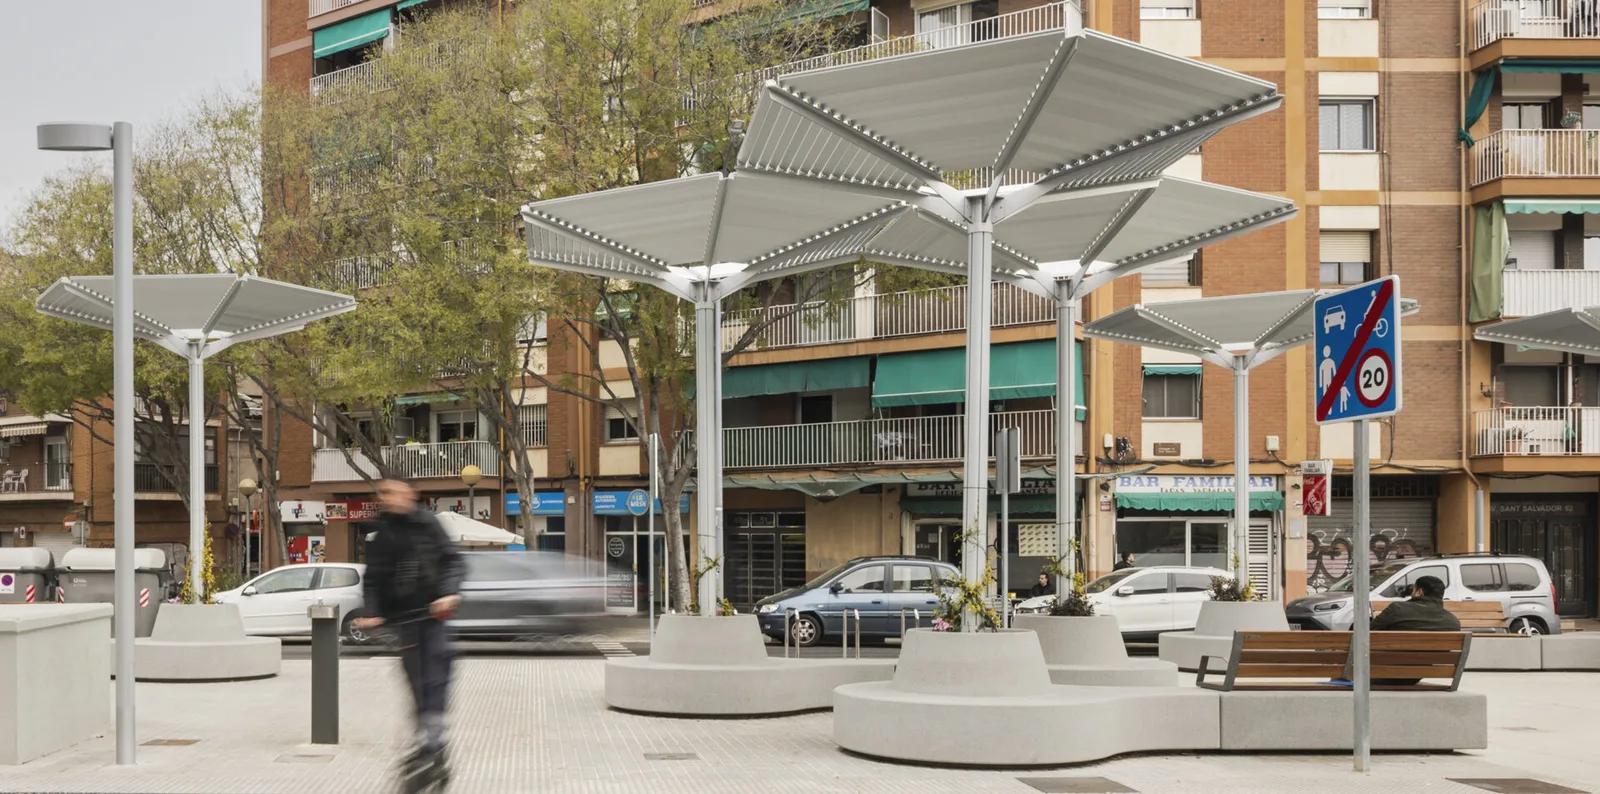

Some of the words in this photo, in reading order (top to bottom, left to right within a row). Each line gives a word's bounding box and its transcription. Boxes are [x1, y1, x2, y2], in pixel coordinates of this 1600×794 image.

[1362, 367, 1385, 389] 20
[1118, 476, 1160, 488] BAR
[1173, 476, 1274, 488] FAMILAR
[1522, 504, 1562, 512] SALVADOR
